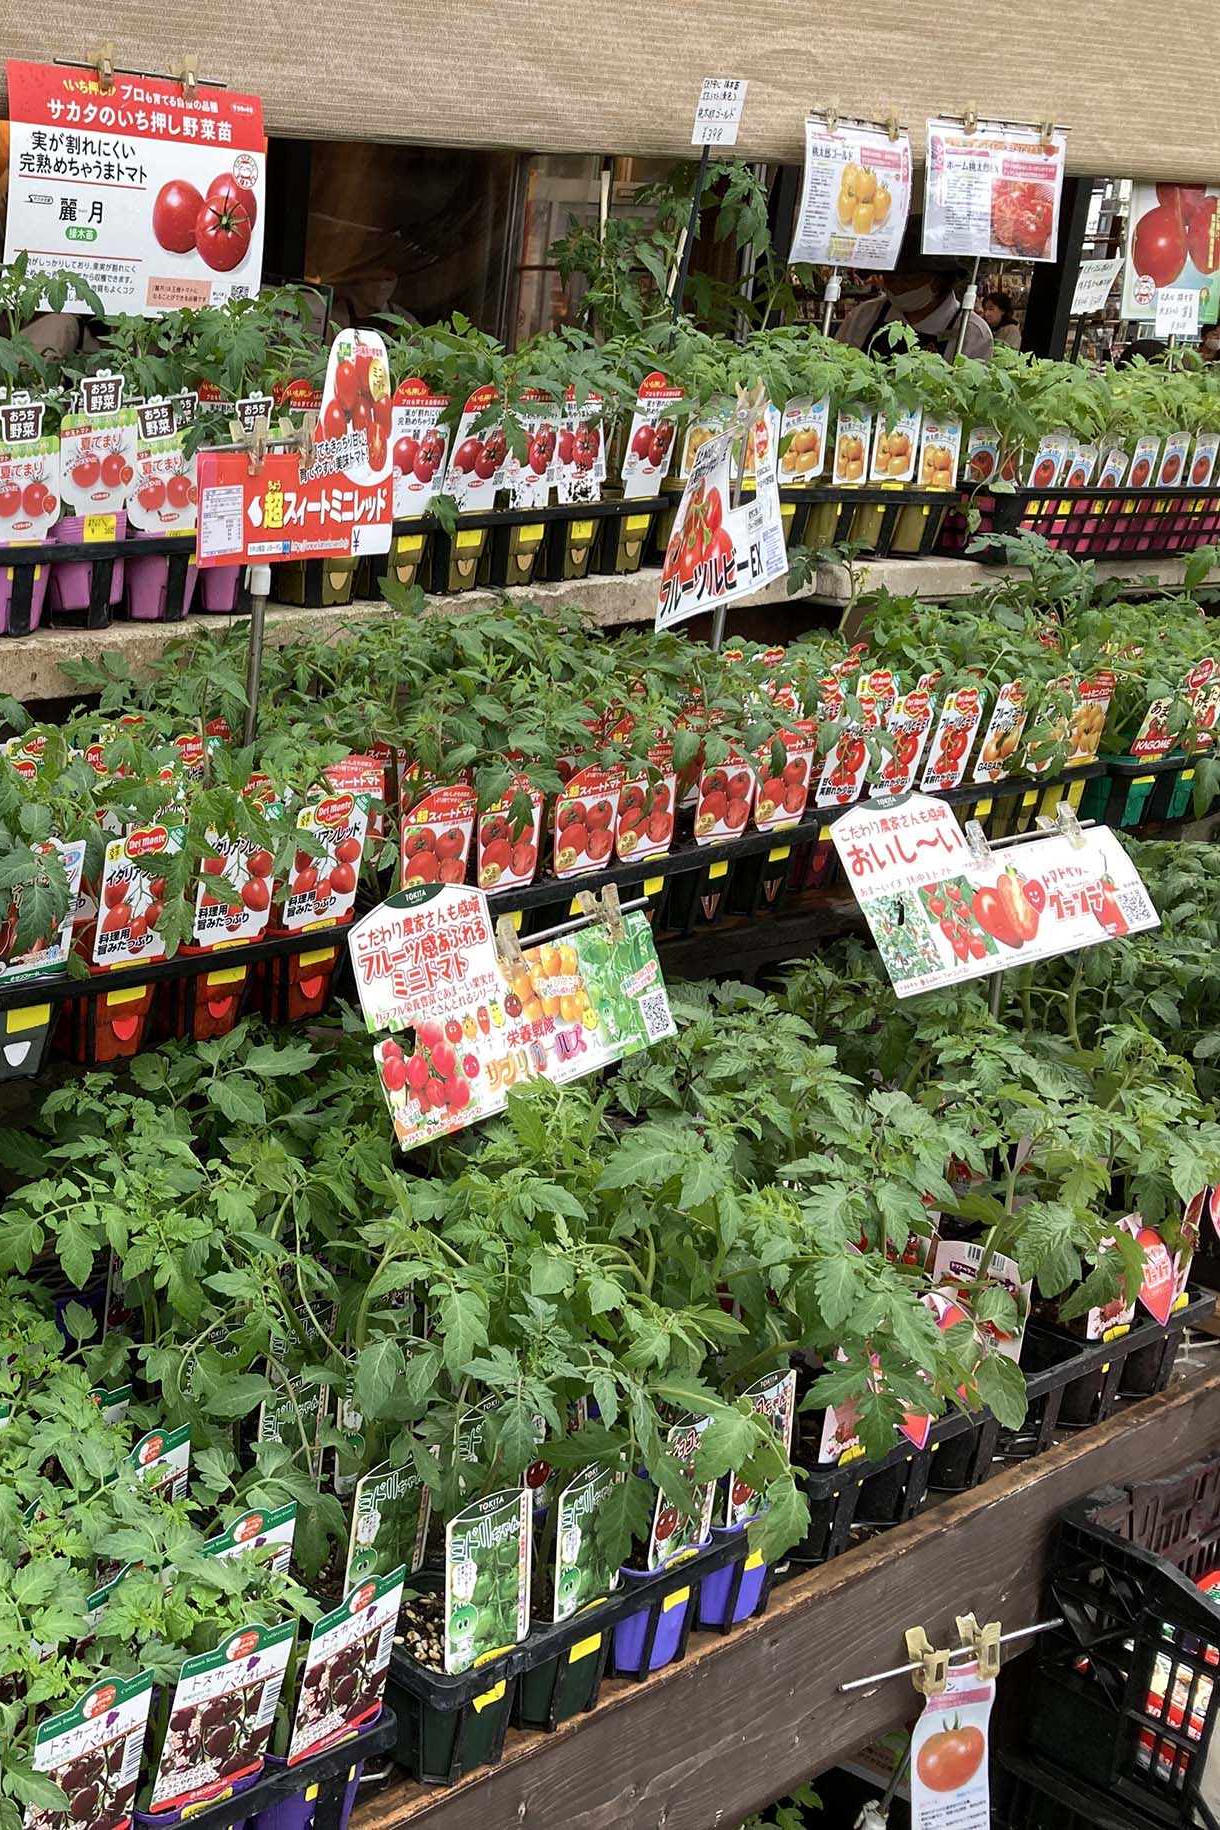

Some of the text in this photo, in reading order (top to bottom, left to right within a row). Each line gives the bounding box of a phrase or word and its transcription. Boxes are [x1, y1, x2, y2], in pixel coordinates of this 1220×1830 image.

[47, 100, 232, 142] サカタのいち押し野菜苗
[32, 132, 135, 159] 実が割れにくい
[20, 154, 147, 185] 完熟めちゃうまトマト
[91, 382, 115, 394] おうち
[91, 394, 116, 410] 野菜
[10, 409, 34, 421] おうち
[144, 408, 169, 420] おうち
[10, 422, 38, 440] 野菜
[145, 420, 173, 435] 野菜
[80, 435, 122, 451] 夏てまり
[1, 462, 43, 479] 夏てまり
[142, 456, 183, 475] 夏てまり
[264, 488, 387, 528] 超スィートミニレッド
[1136, 739, 1171, 750] KAGOME
[318, 801, 352, 816] Del Monte
[129, 834, 166, 850] Del Monte
[288, 891, 316, 906] 料理用
[405, 890, 426, 900] TOKITA
[198, 905, 227, 919] 料理用
[287, 896, 336, 918] 旨みたっぷり
[198, 914, 249, 930] 旨みたっぷり
[97, 934, 153, 955] 旨みたっぷり
[99, 929, 130, 944] 料理用
[360, 919, 486, 982] フルーツ感あふれる
[392, 957, 468, 997] ミニトマト
[422, 986, 501, 1019] たくさんとれるシリーズ
[506, 1016, 556, 1047] 栄養戦隊
[479, 1498, 505, 1511] TOKITA
[451, 1516, 520, 1564] ミドリちゃん
[192, 1663, 244, 1691] トスカーナ
[222, 1664, 276, 1693] バイオレット
[51, 1719, 102, 1755] トスカーナ
[82, 1717, 136, 1753] バイオレット
